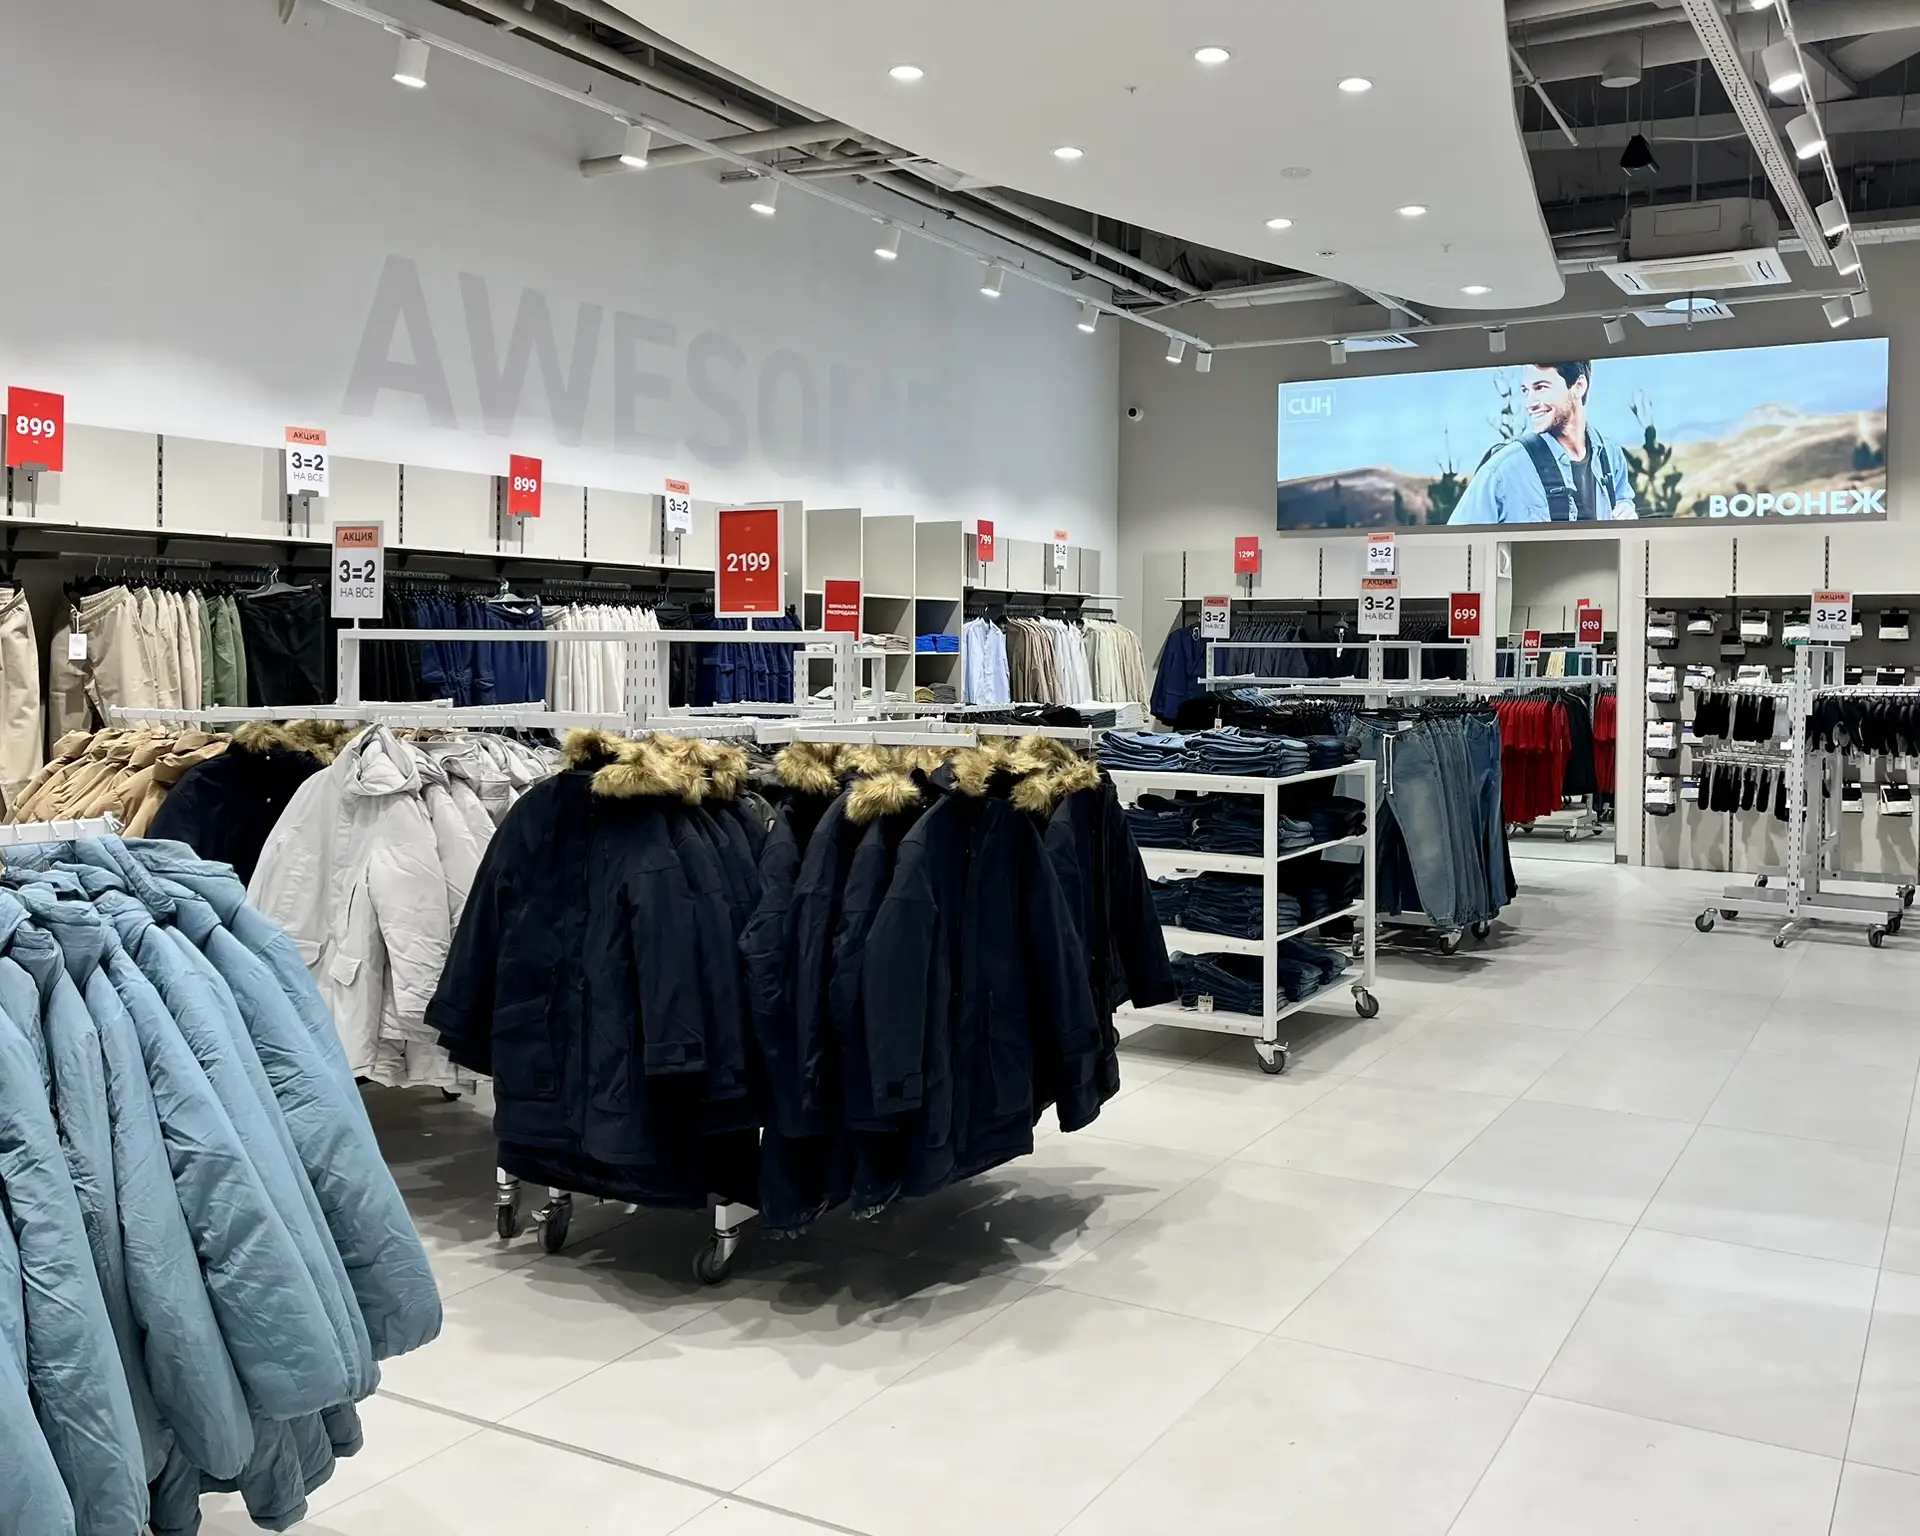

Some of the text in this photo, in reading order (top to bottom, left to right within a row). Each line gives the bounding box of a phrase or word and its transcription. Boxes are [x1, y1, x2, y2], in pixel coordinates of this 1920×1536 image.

[15, 416, 56, 439] 899
[293, 431, 320, 442] АКЦИЯ
[291, 451, 324, 472] 3=2
[293, 472, 324, 483] НА ВСЕ
[513, 476, 537, 493] 899
[669, 498, 689, 514] 3=2
[1709, 489, 1887, 518] ВОРОНЕЖ
[343, 531, 373, 543] АКЦИЯ
[980, 533, 992, 545] 799
[1055, 544, 1067, 555] 3=2
[1370, 547, 1392, 558] 3=2
[726, 552, 771, 573] 2199
[339, 560, 376, 583] 3=2
[340, 587, 375, 599] НА ВСЕ
[1364, 596, 1395, 611] 3=2
[1204, 611, 1226, 623] 3=2
[1454, 608, 1477, 620] 699
[1816, 609, 1847, 622] 3=2
